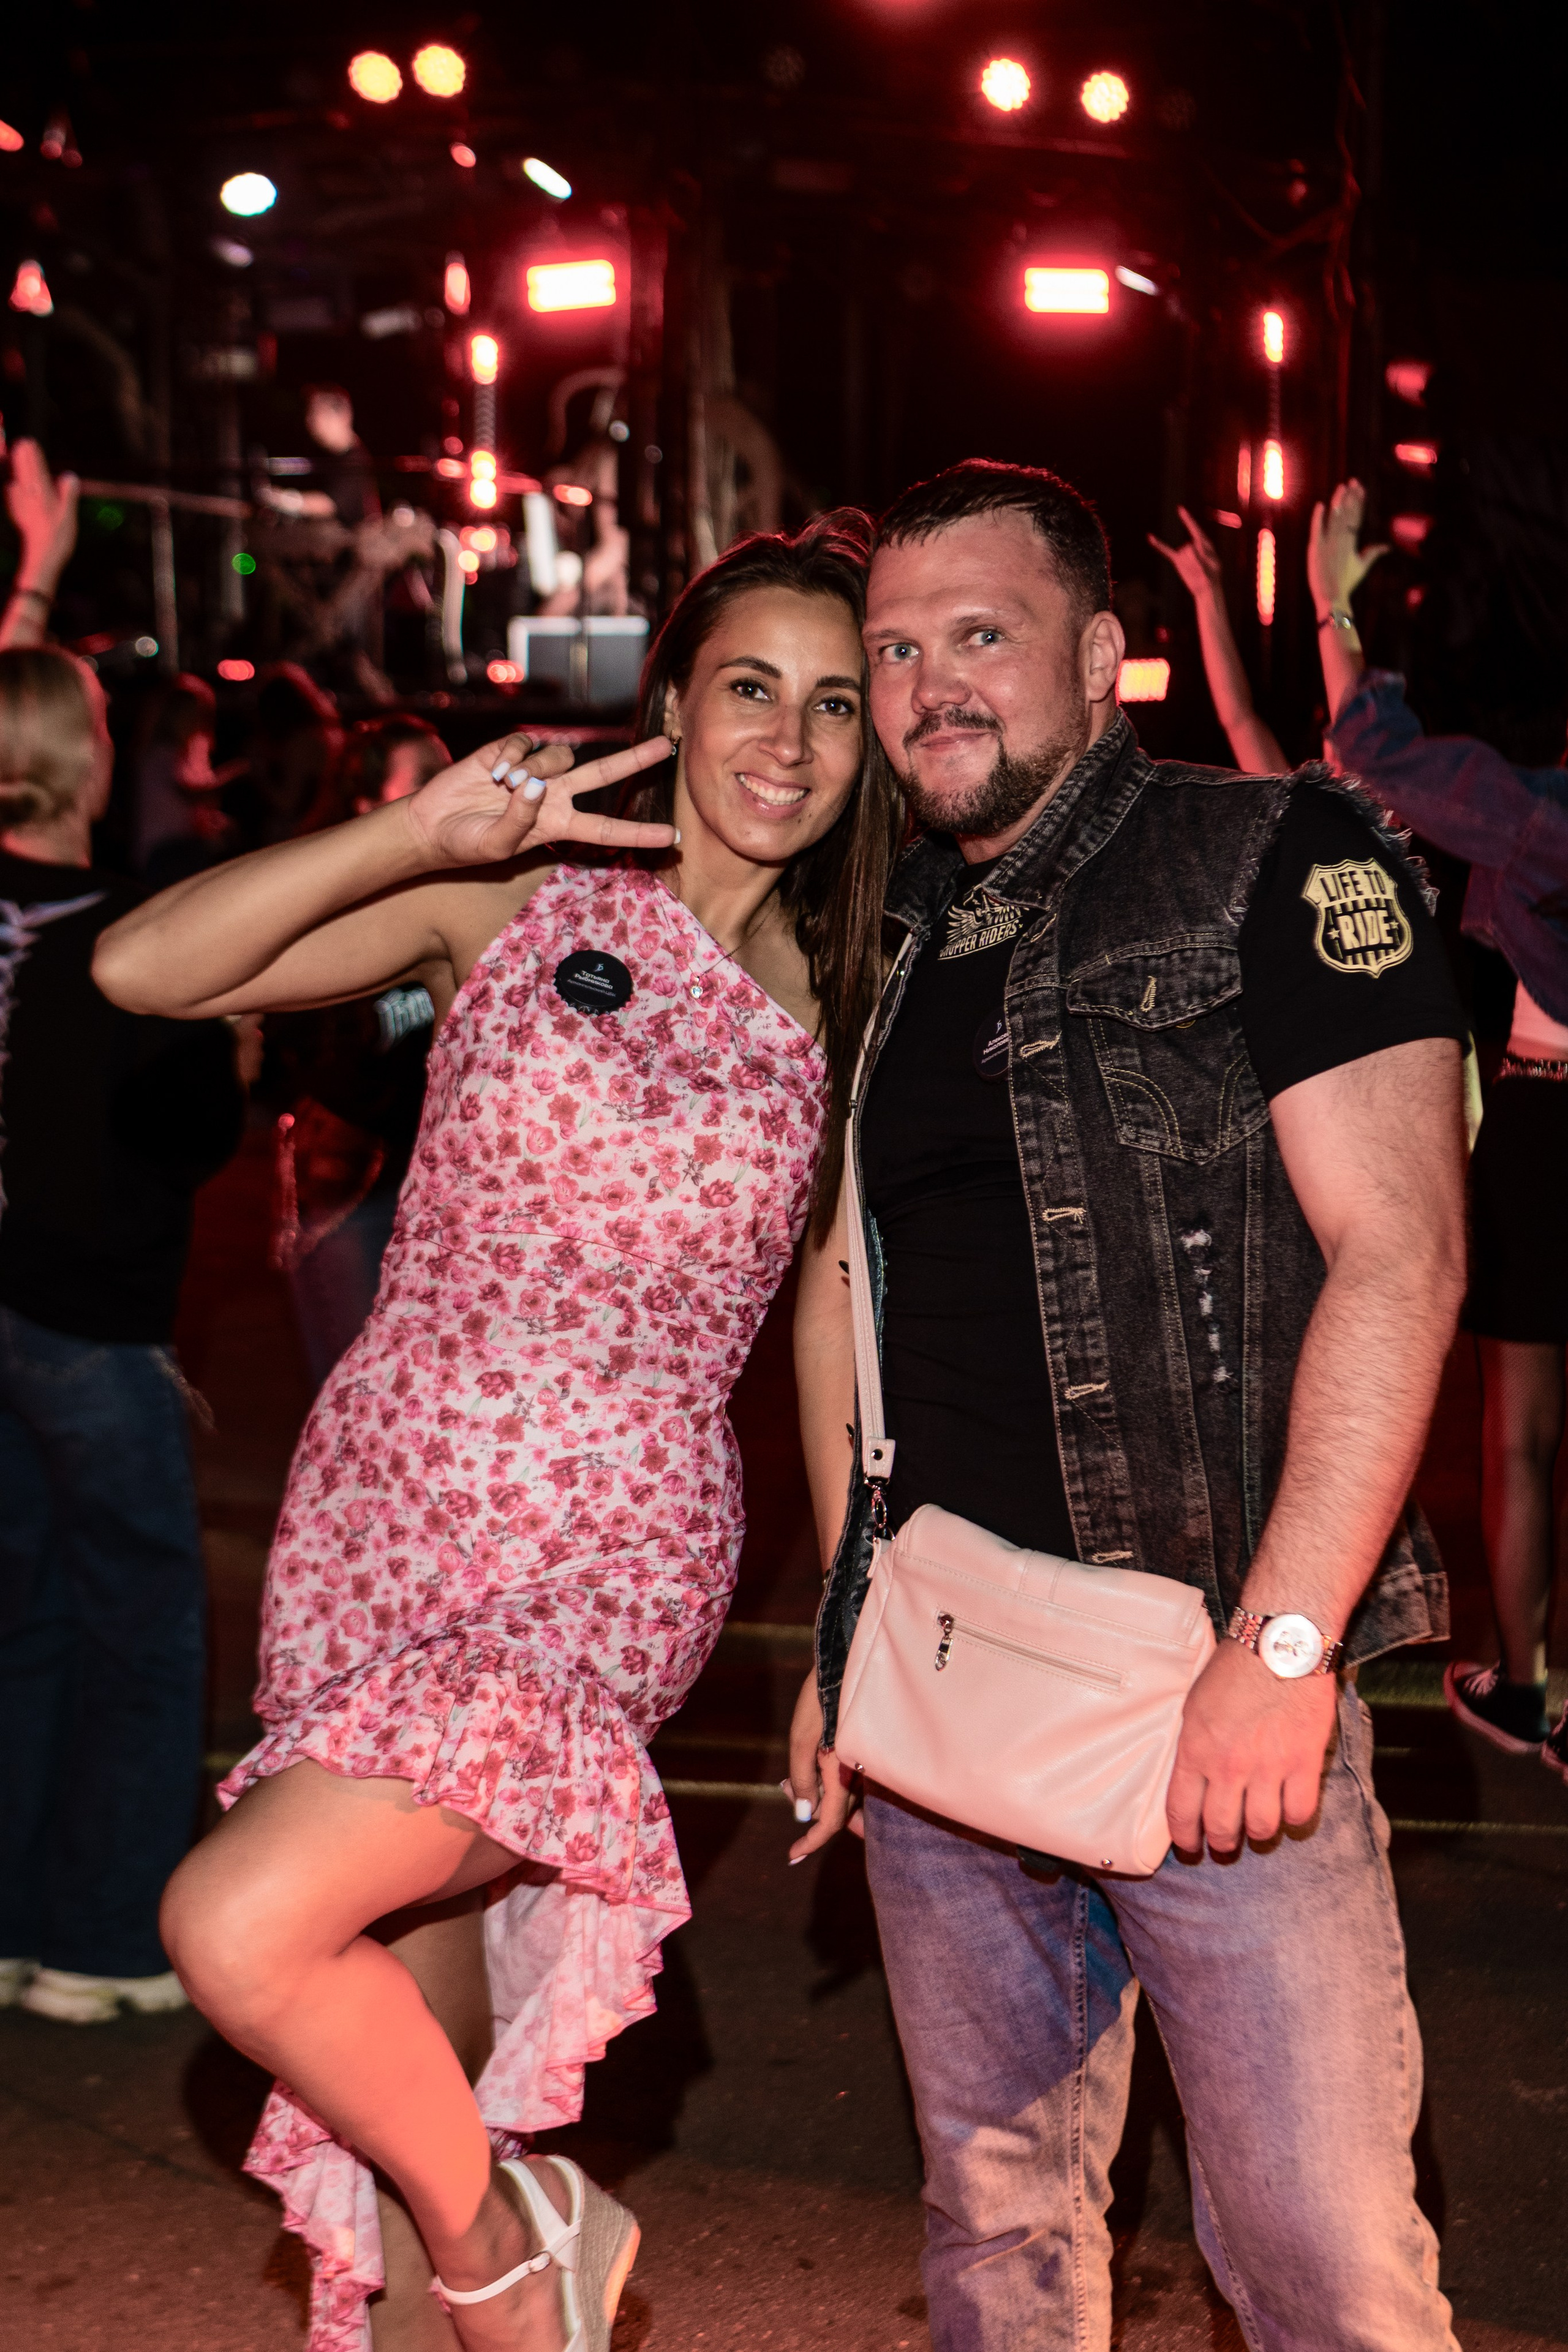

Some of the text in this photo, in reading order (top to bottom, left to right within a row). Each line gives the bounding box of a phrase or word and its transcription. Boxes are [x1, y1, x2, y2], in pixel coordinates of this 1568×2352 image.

[1319, 870, 1386, 902] LIFE TO
[979, 919, 1019, 947] RIDERS
[1337, 910, 1393, 950] RIDE
[575, 973, 613, 989] Рыбникова
[582, 970, 610, 984] Татьяна
